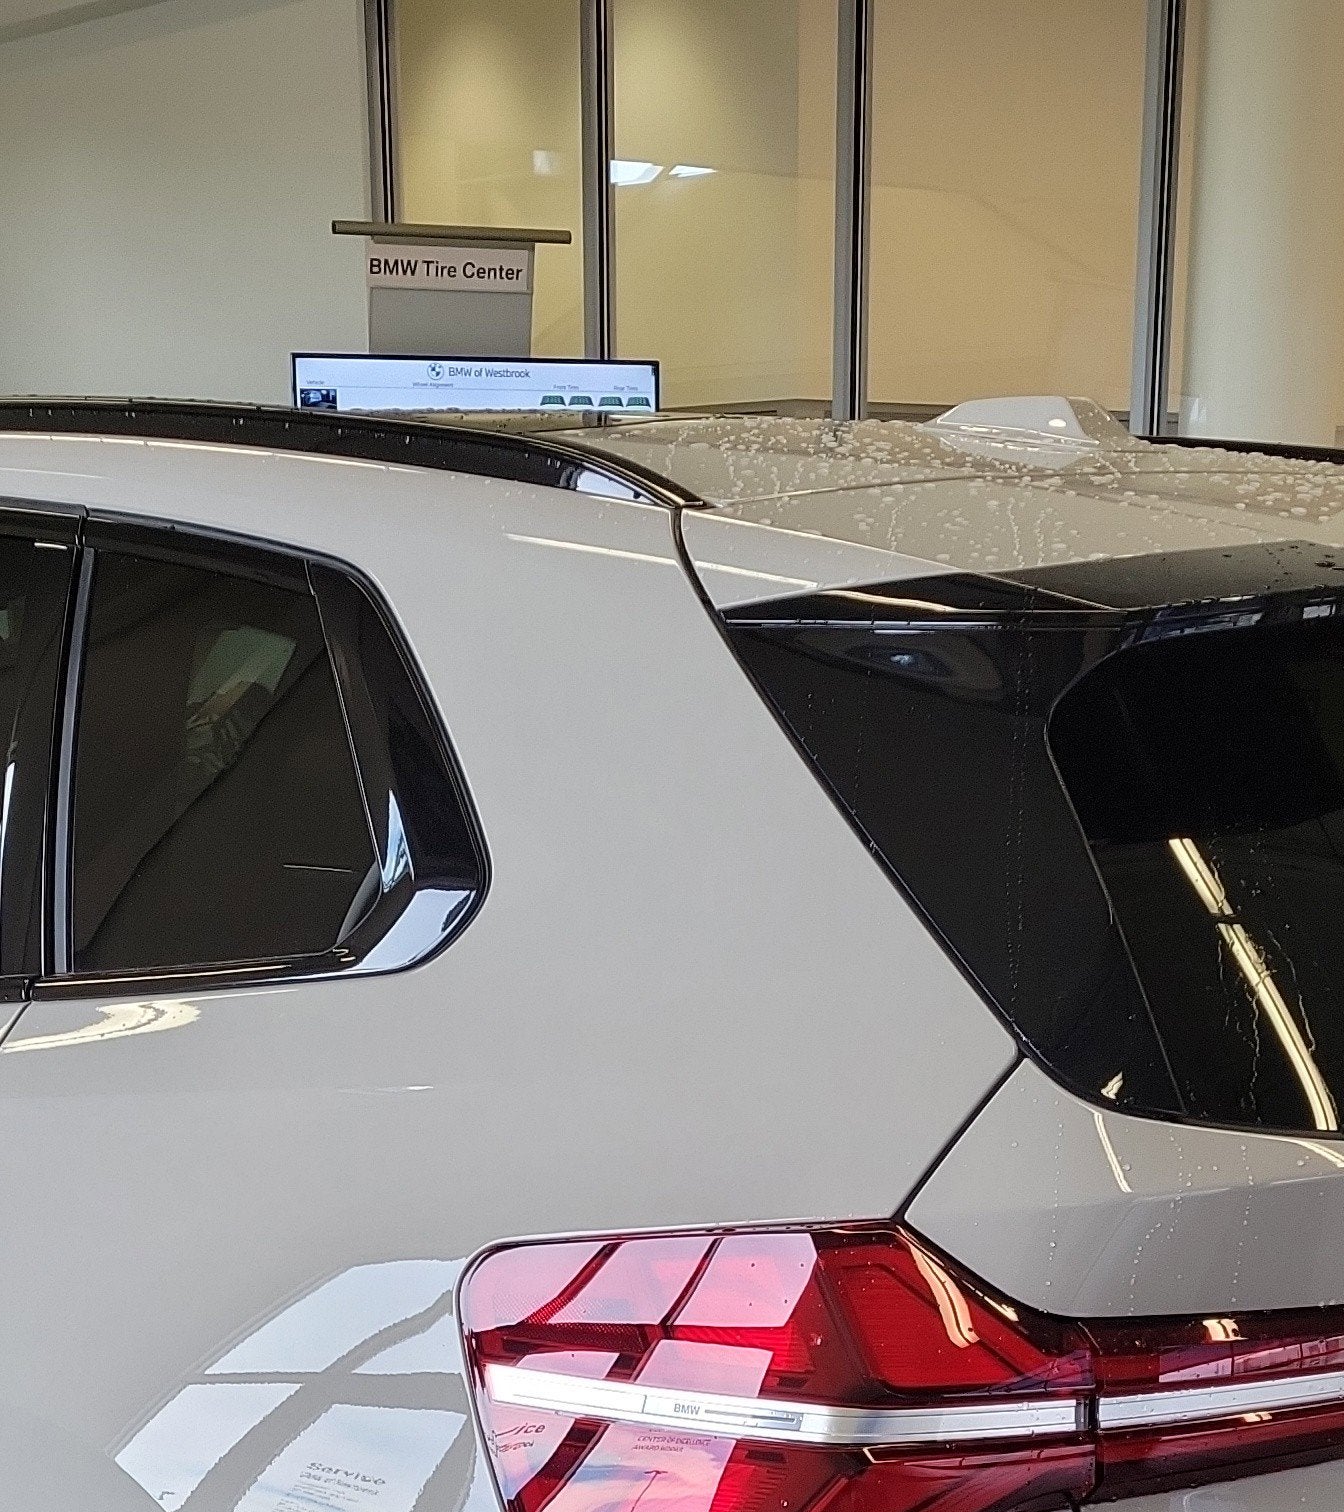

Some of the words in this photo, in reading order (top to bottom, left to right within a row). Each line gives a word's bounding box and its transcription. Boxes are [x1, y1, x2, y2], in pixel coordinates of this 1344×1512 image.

[369, 257, 418, 277] BMW
[422, 260, 457, 278] Tire
[462, 261, 524, 281] Center
[448, 366, 472, 378] BMW
[474, 366, 483, 378] of
[485, 367, 531, 379] Westbrook
[673, 1403, 700, 1415] BMW
